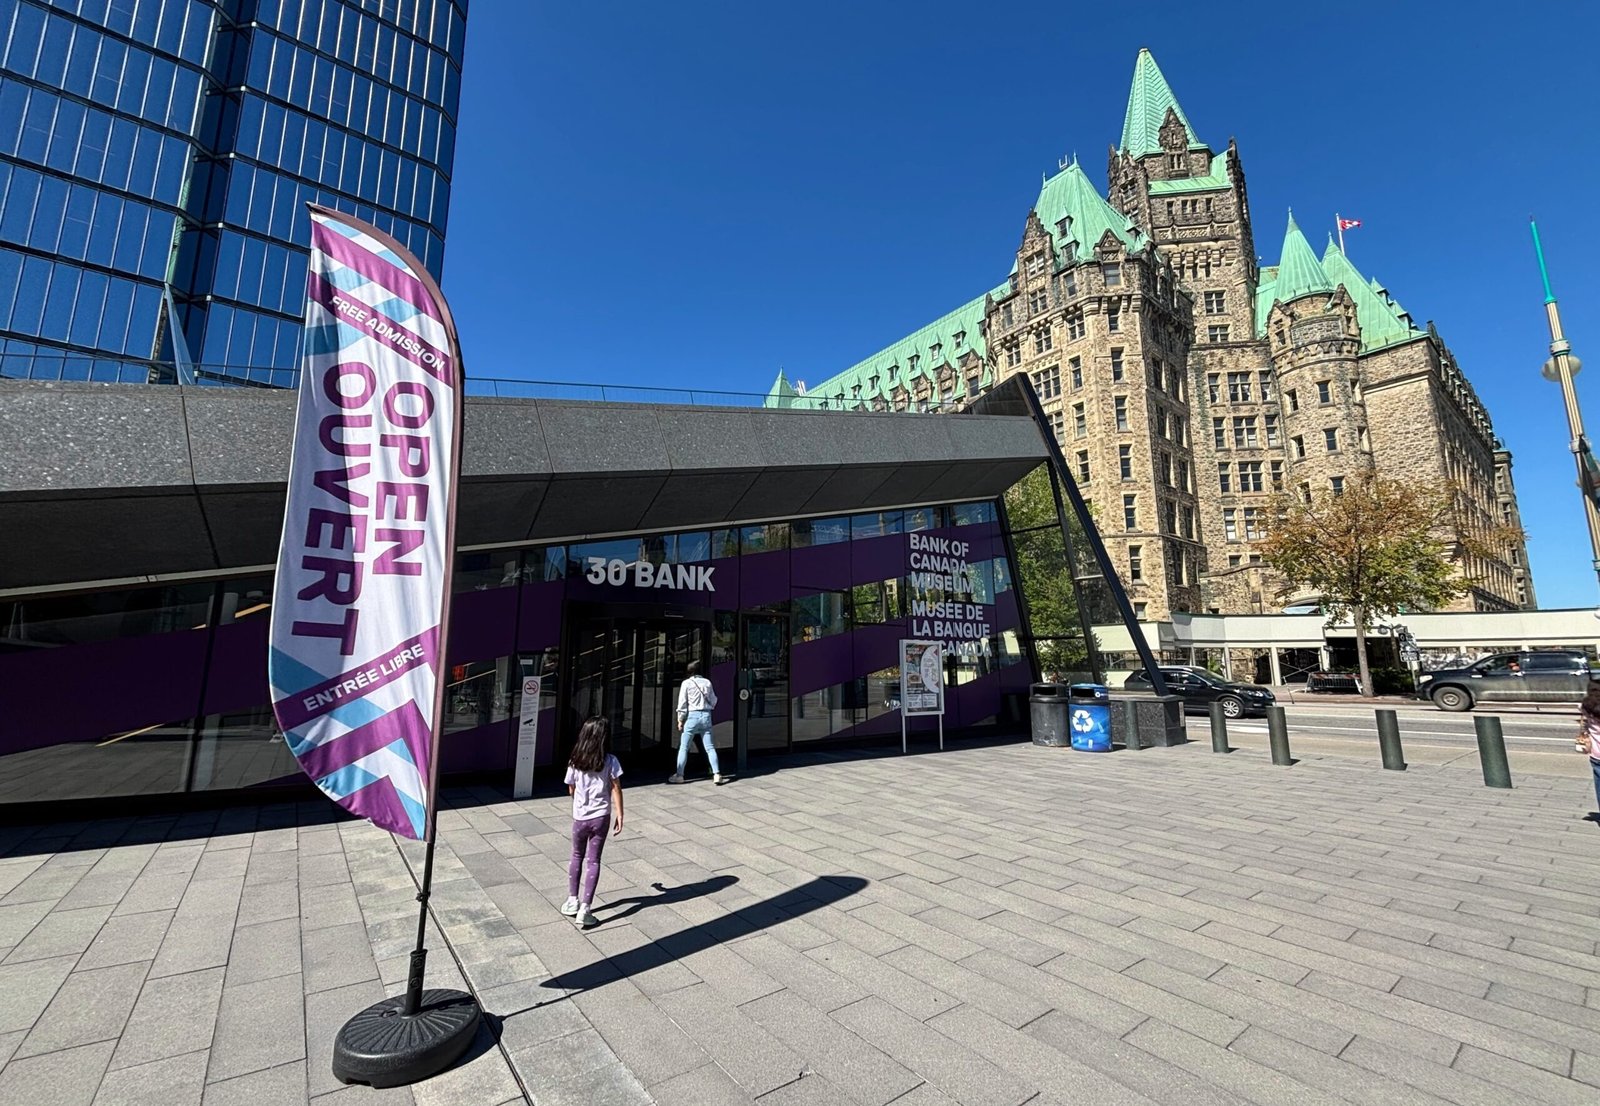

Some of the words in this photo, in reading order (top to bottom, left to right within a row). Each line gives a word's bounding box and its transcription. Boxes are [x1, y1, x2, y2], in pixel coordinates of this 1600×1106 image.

[330, 295, 368, 326] FREE
[366, 317, 446, 373] ADMISSION
[372, 381, 435, 576] OPEN
[291, 361, 377, 656] OUVERT
[909, 533, 950, 555] BANK
[951, 540, 969, 558] OF
[586, 556, 627, 587] 30
[634, 560, 716, 592] BANK
[909, 552, 968, 575] CANADA
[911, 571, 975, 594] MUSEUM
[911, 598, 963, 620] MUSÉE
[966, 604, 984, 621] DE
[912, 619, 932, 637] LA
[934, 621, 991, 640] BANQUE
[302, 668, 380, 712] ENTRÉE
[379, 642, 425, 678] LIBRE
